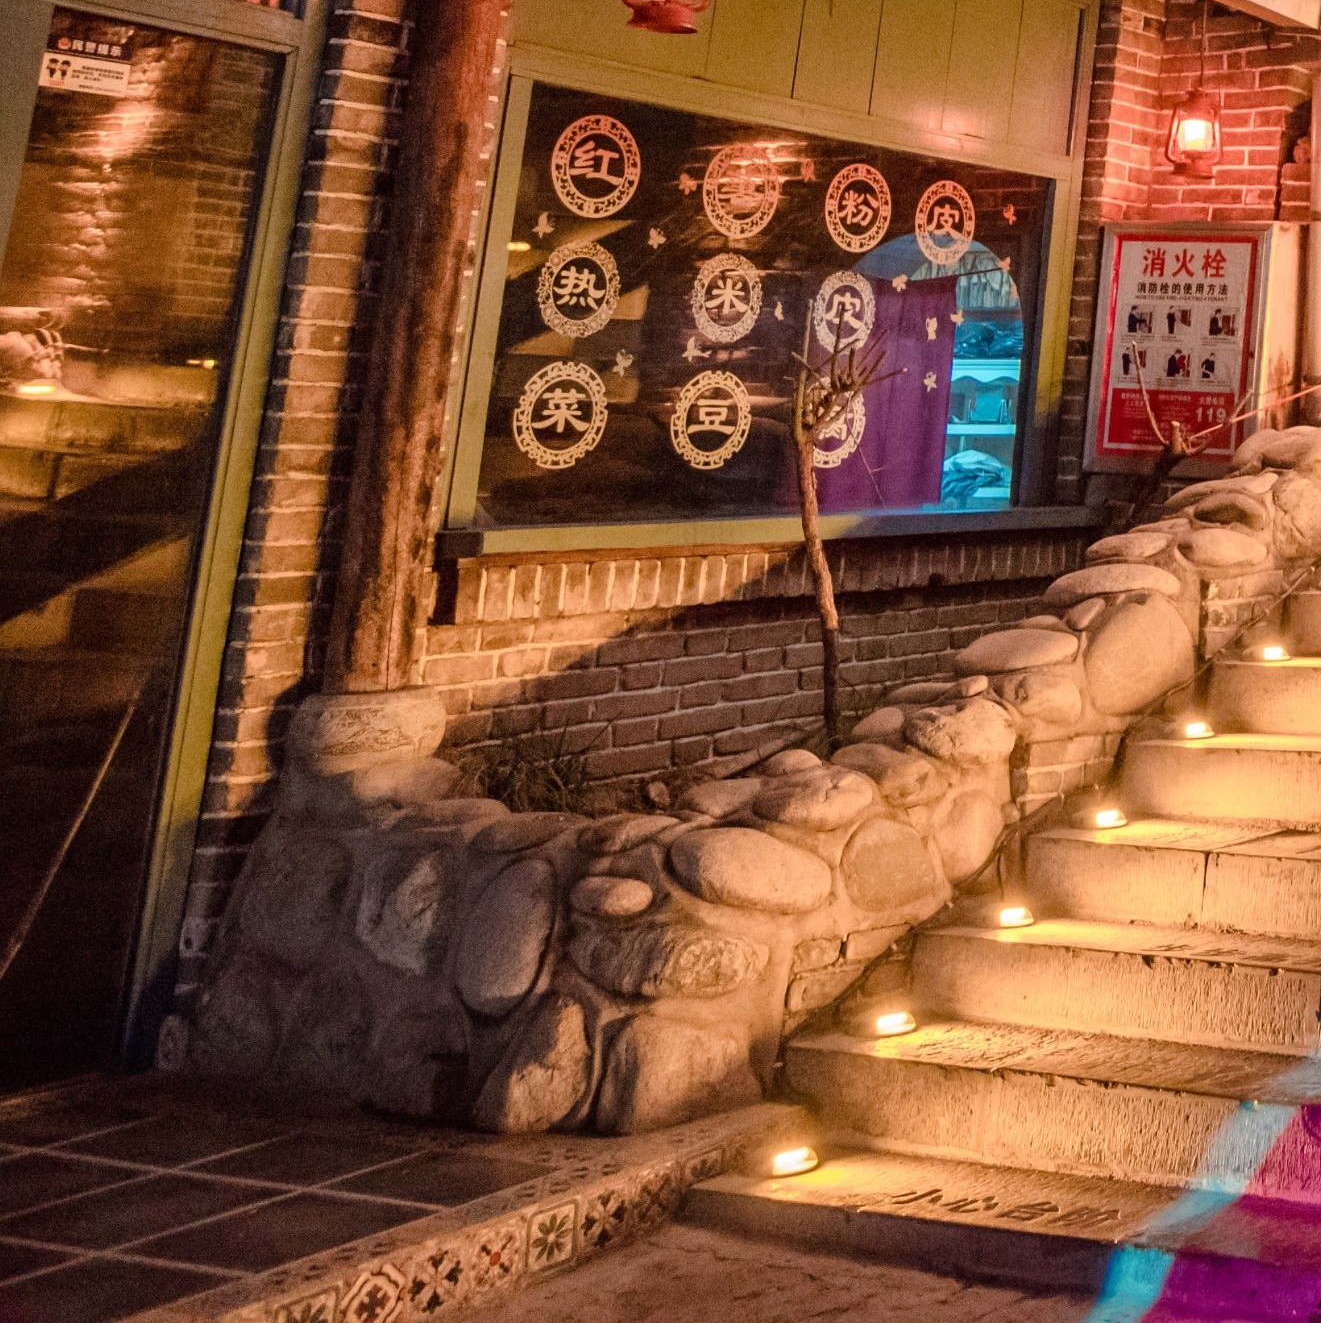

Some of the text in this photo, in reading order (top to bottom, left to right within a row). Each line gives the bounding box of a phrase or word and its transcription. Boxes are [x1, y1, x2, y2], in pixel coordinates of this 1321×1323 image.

[1142, 247, 1227, 278] 消火栓
[1136, 281, 1229, 296] 消防栓的使用方法
[1195, 407, 1227, 423] 119
